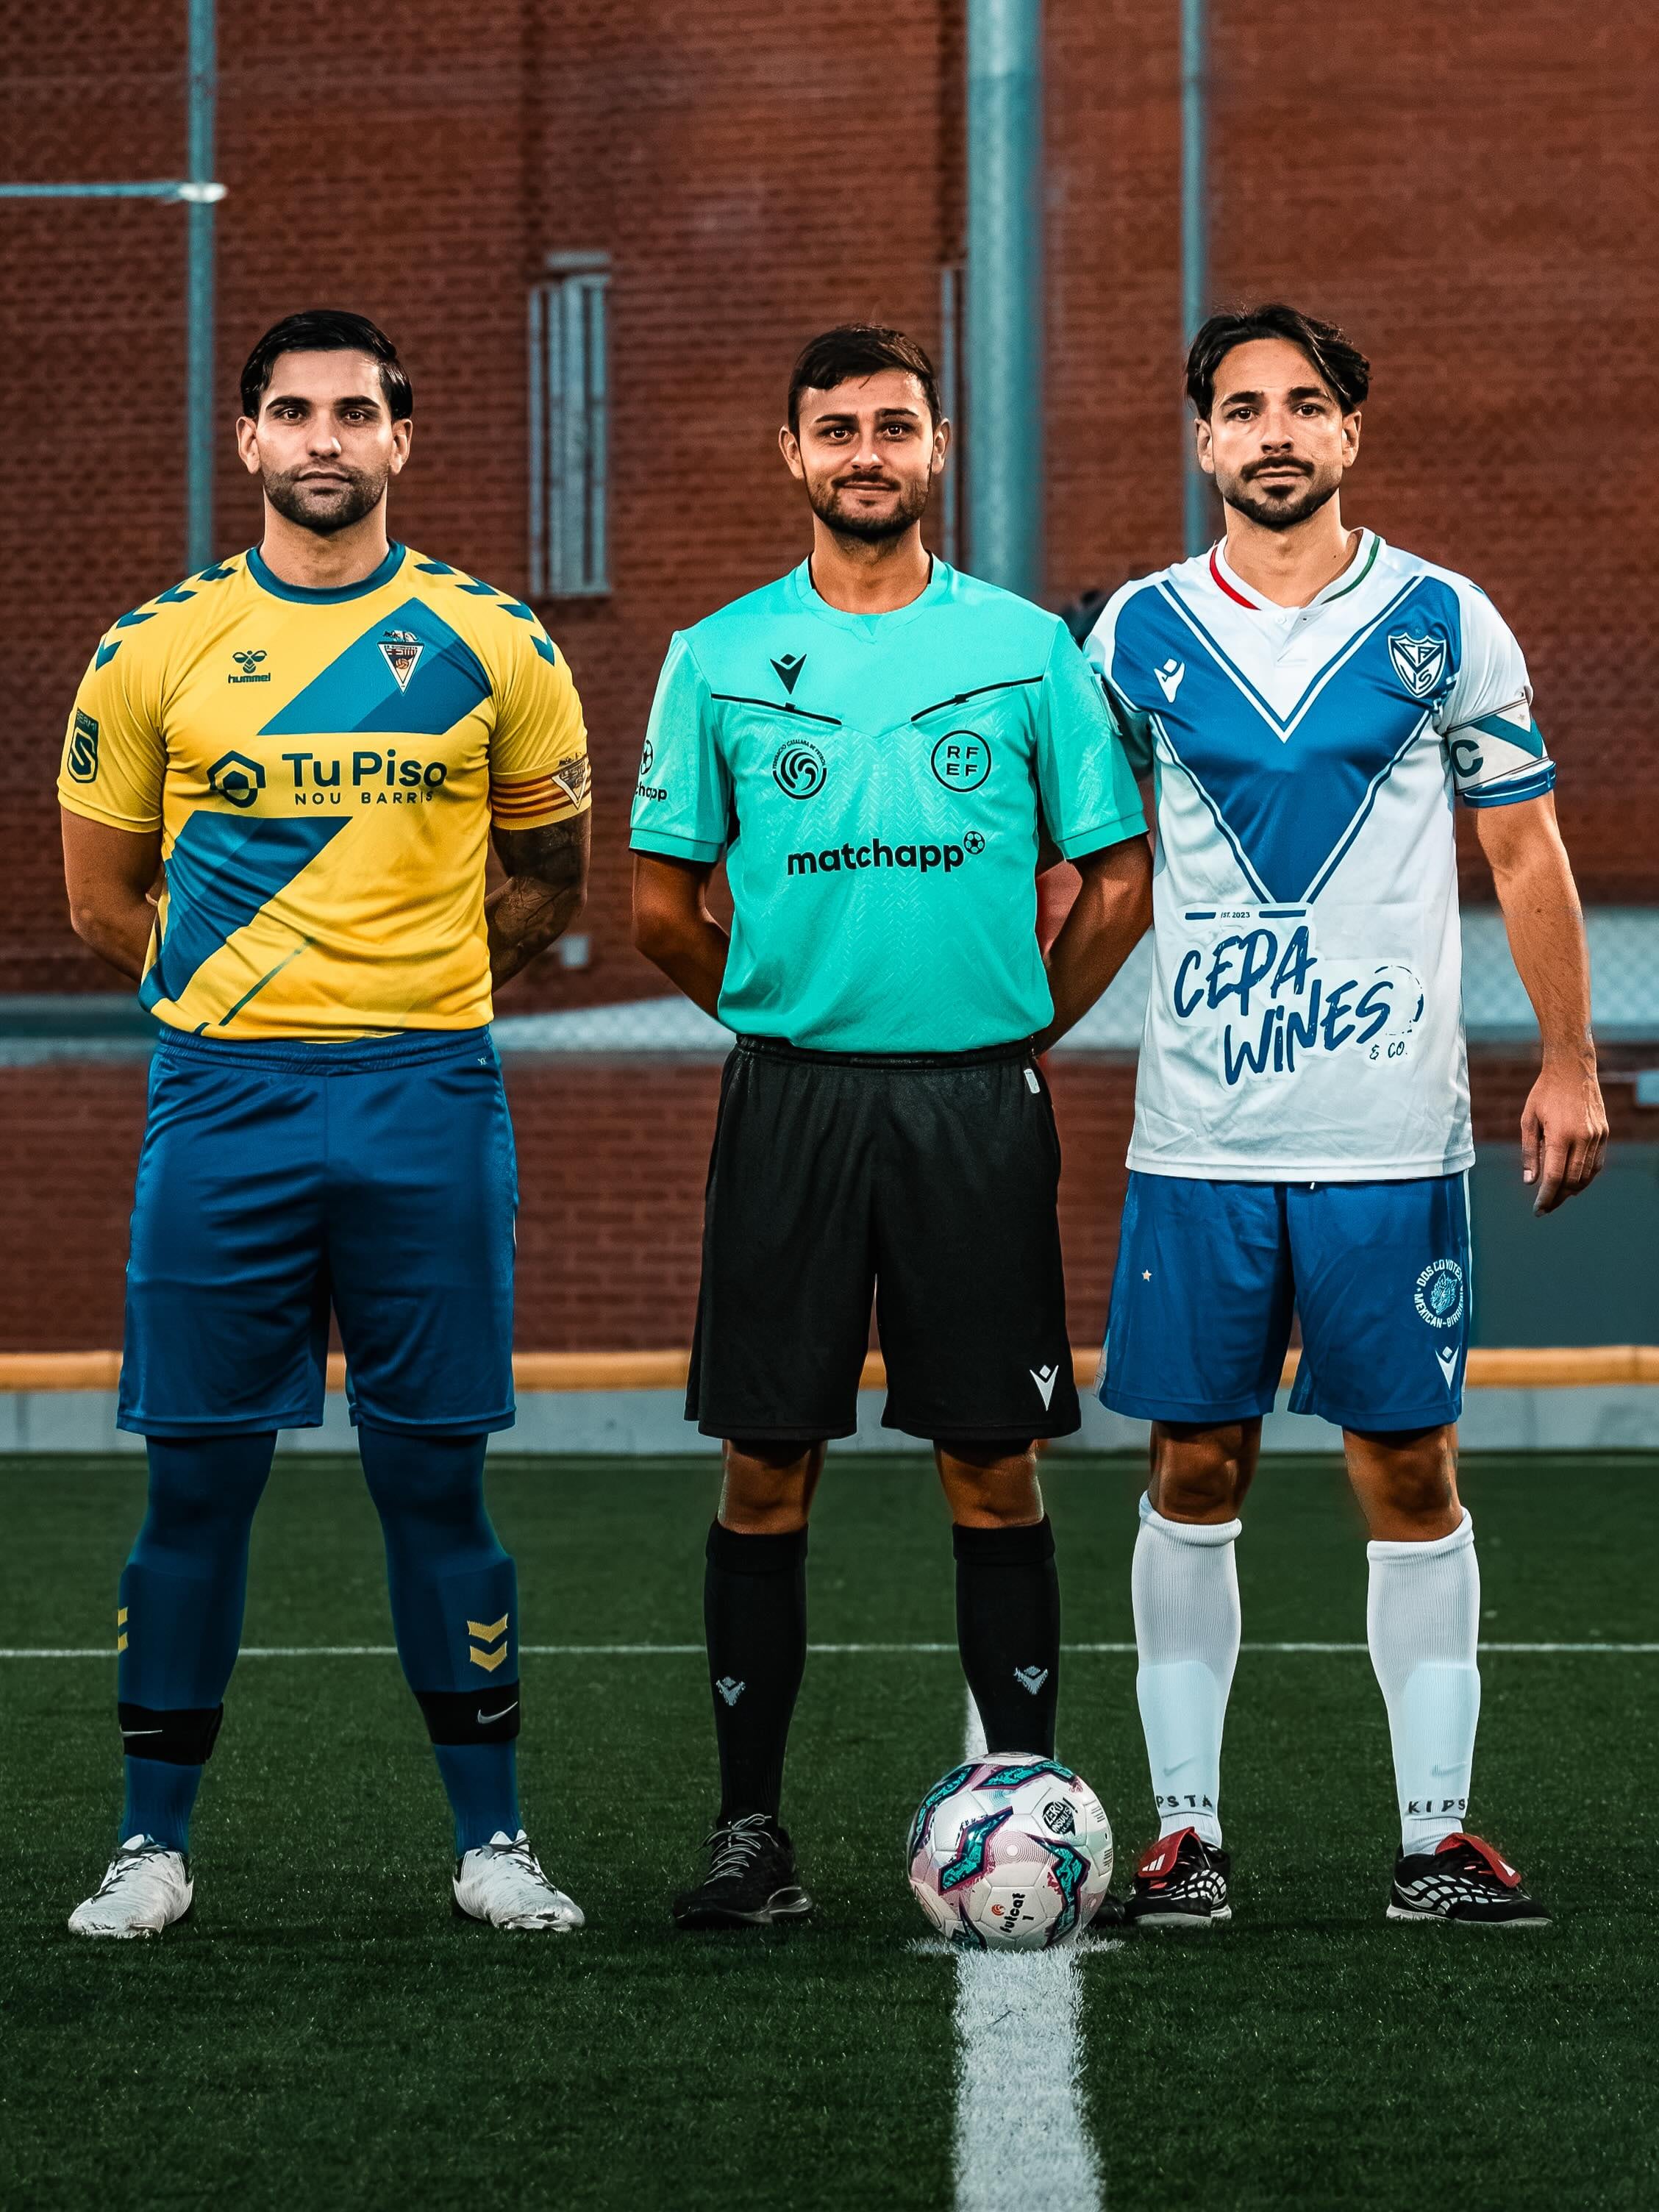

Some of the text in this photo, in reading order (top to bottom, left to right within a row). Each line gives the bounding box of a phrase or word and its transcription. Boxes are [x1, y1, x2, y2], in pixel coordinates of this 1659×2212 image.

[228, 673, 271, 683] hummel
[1451, 739, 1483, 778] C
[295, 791, 433, 805] NOU BARRIS
[788, 838, 964, 876] matchapp
[1174, 926, 1318, 1018] CEPA
[1416, 1266, 1434, 1287] DOS
[1042, 1801, 1063, 1825] ZERO
[999, 1893, 1026, 1933] futcat
